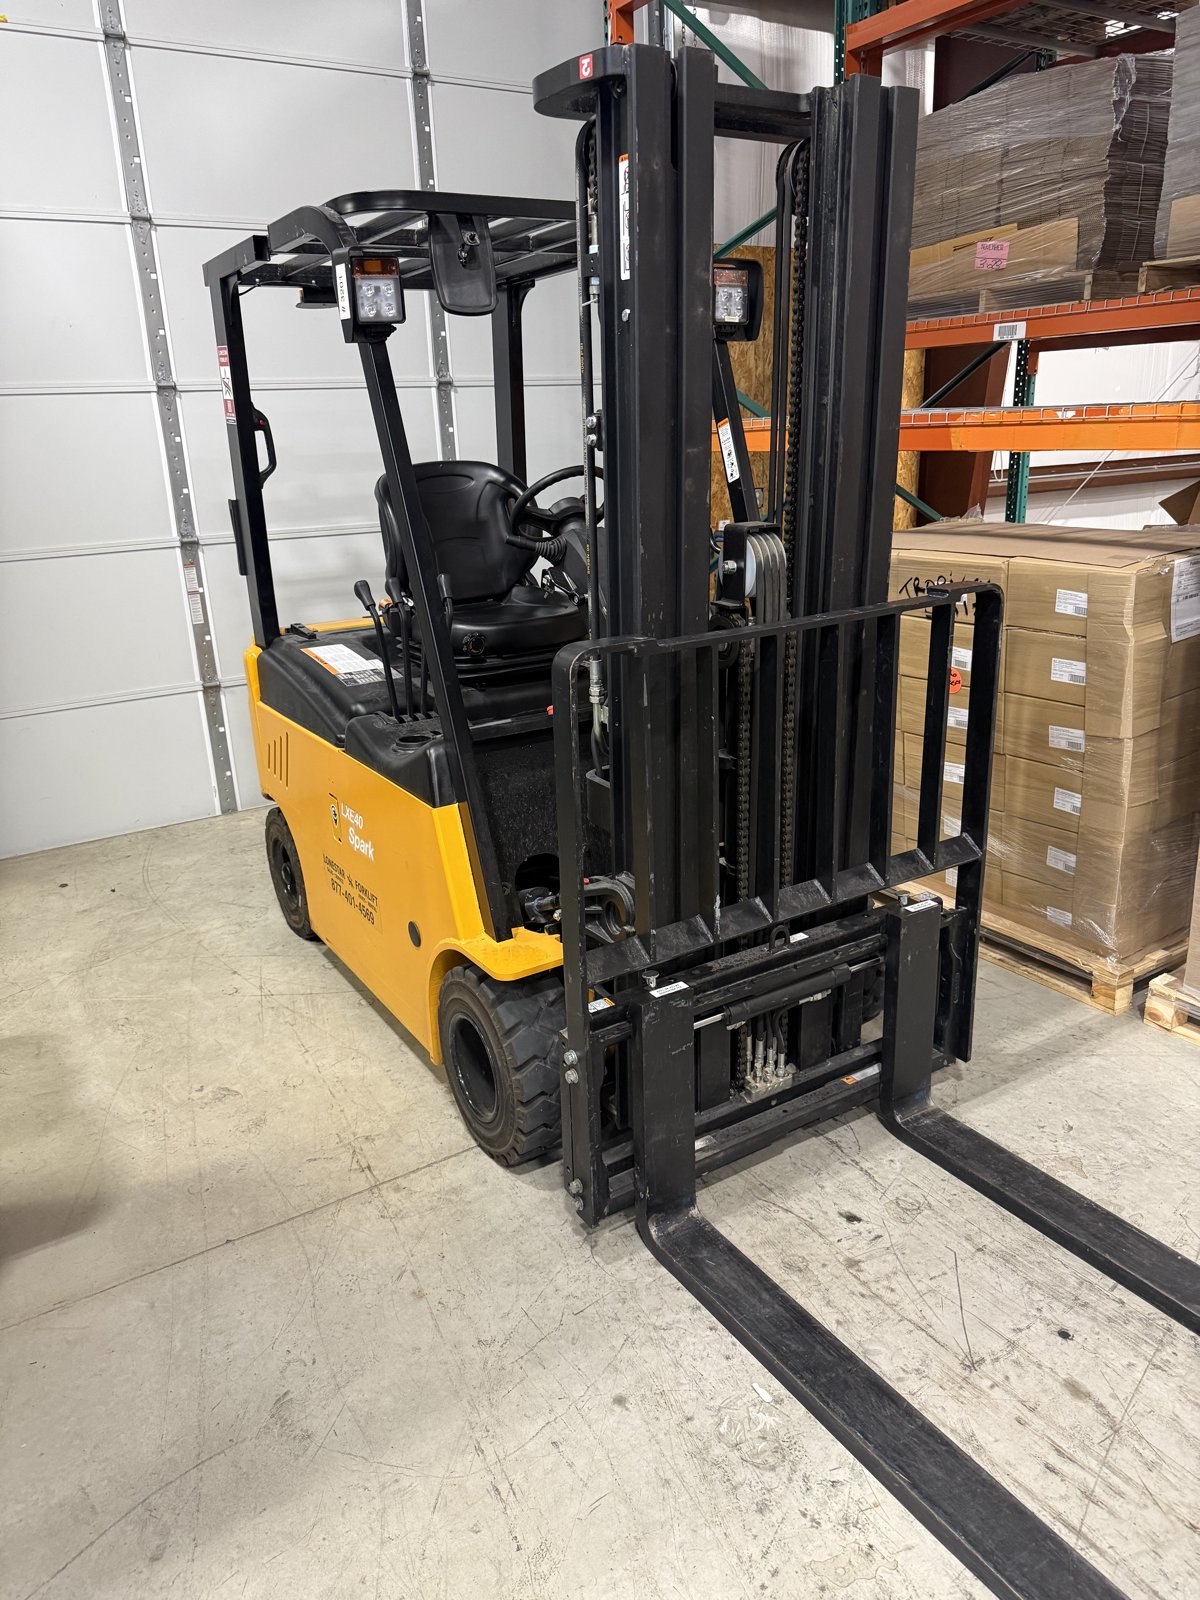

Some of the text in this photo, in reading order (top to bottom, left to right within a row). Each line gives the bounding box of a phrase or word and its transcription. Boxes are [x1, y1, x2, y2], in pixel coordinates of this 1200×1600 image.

[341, 802, 364, 829] LXE40
[348, 826, 375, 861] Spark
[323, 853, 346, 880] LONESTAR
[354, 879, 378, 907] FORKLIFT
[330, 878, 375, 926] 877-401-4569
